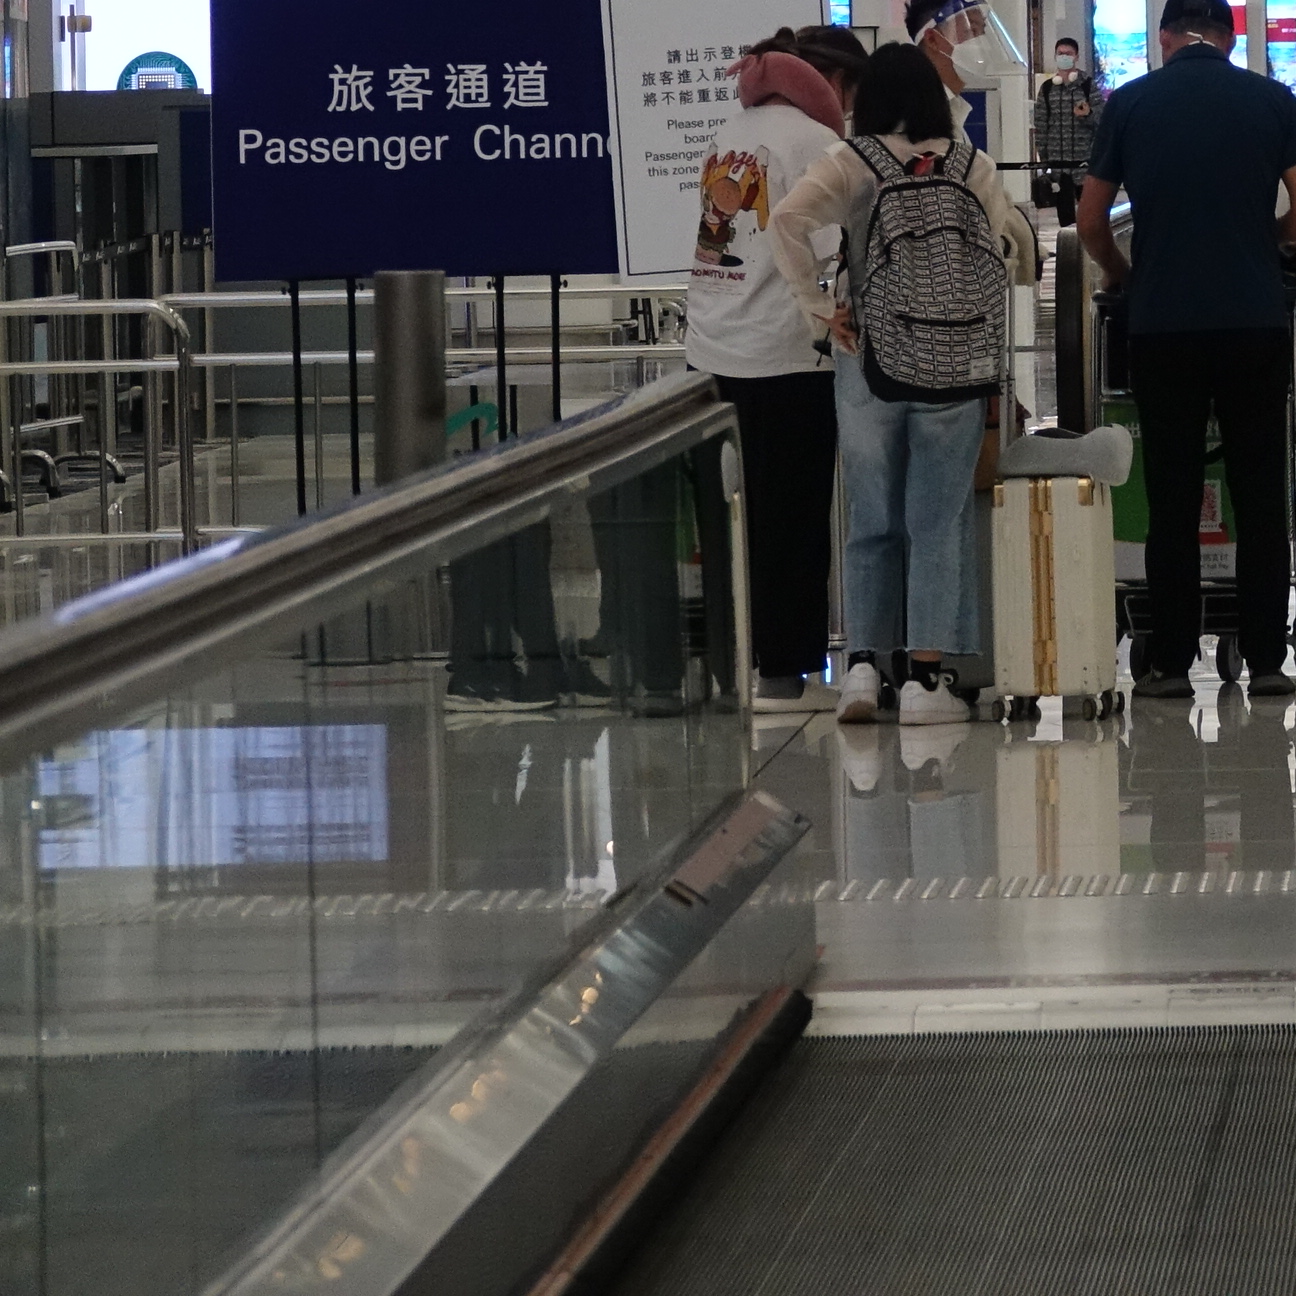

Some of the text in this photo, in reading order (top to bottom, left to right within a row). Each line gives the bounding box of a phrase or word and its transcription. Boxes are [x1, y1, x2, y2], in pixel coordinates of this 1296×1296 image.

[327, 61, 549, 113] 旅客通道
[667, 119, 704, 130] Please
[239, 129, 449, 170] Passenger
[648, 165, 700, 177] this zone
